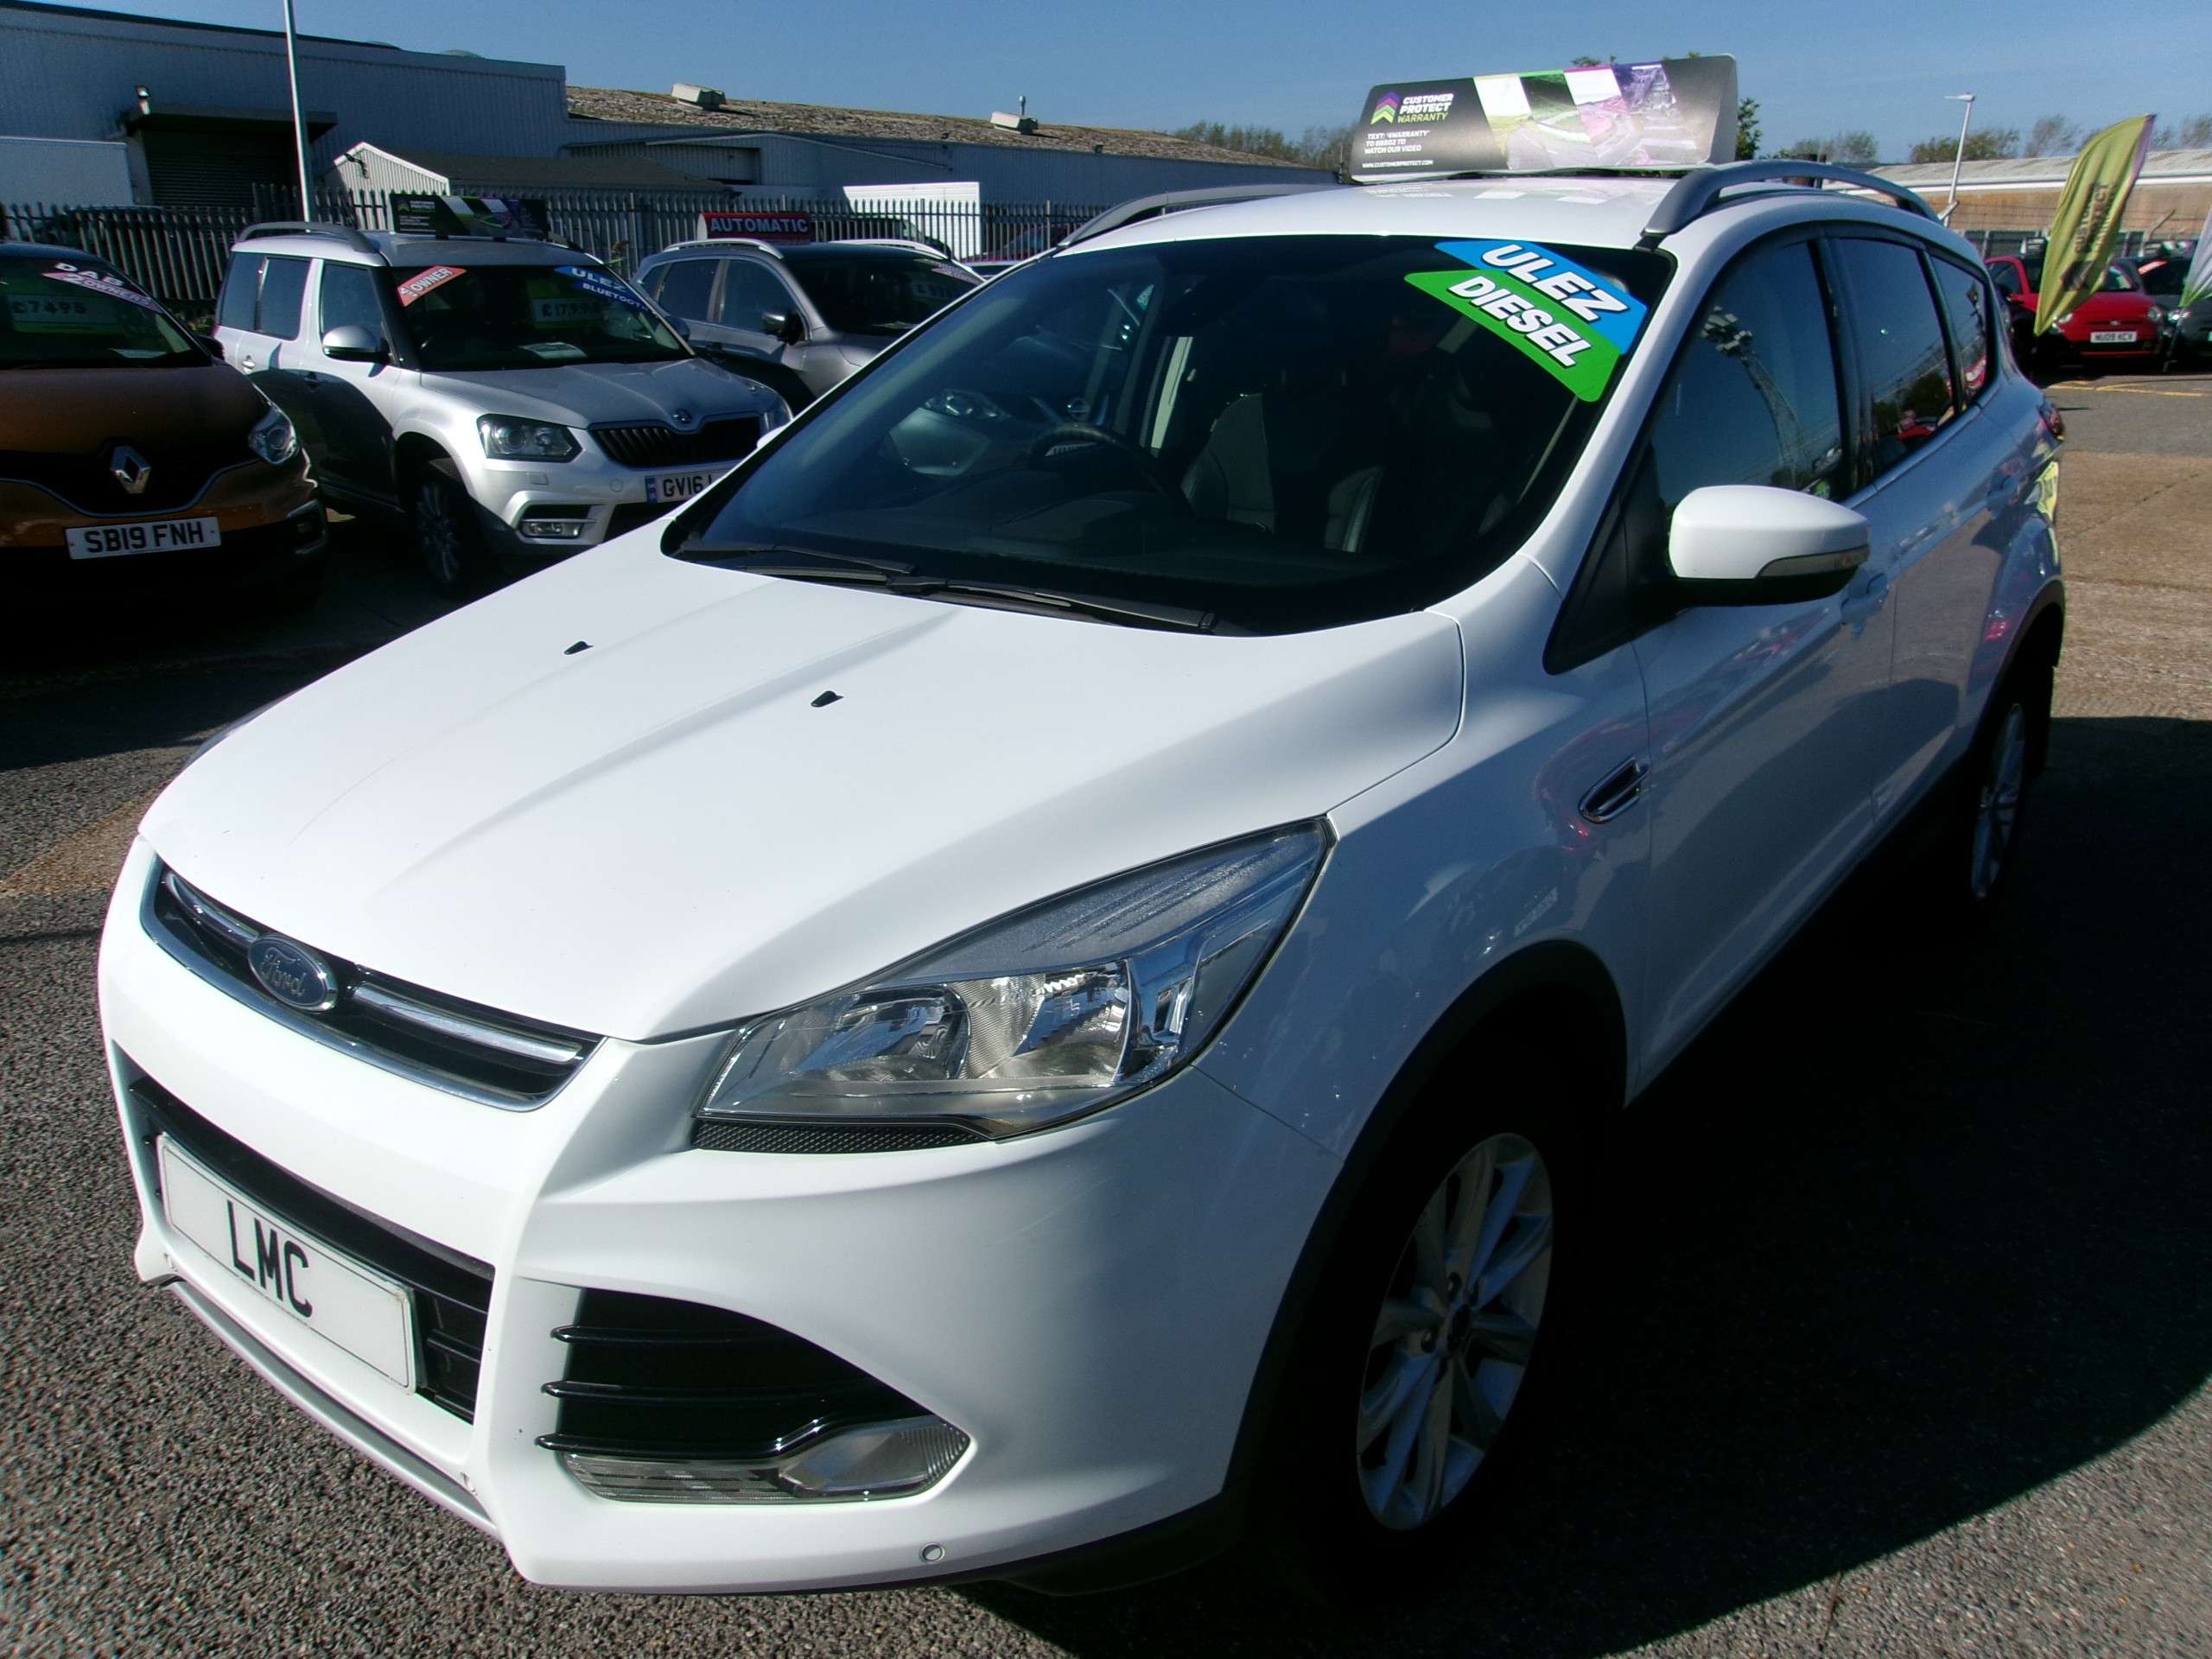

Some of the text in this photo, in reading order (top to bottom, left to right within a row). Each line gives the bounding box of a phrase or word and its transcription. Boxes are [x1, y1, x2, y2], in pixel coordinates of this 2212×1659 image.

[1399, 102, 1452, 115] PROTECT
[1402, 93, 1454, 105] CUSTOMER
[1397, 112, 1449, 124] WARRANTY
[711, 218, 809, 232] AUTOMATIC
[54, 262, 126, 287] DAB
[410, 268, 454, 291] OWNER
[571, 267, 627, 293] ULEZ
[1481, 244, 1630, 322] ULEZ
[1447, 275, 1592, 367] DIESEL
[663, 475, 704, 497] GV16
[84, 521, 205, 554] SB19 FNH
[259, 947, 307, 997] Ford
[226, 1198, 314, 1319] LMC
